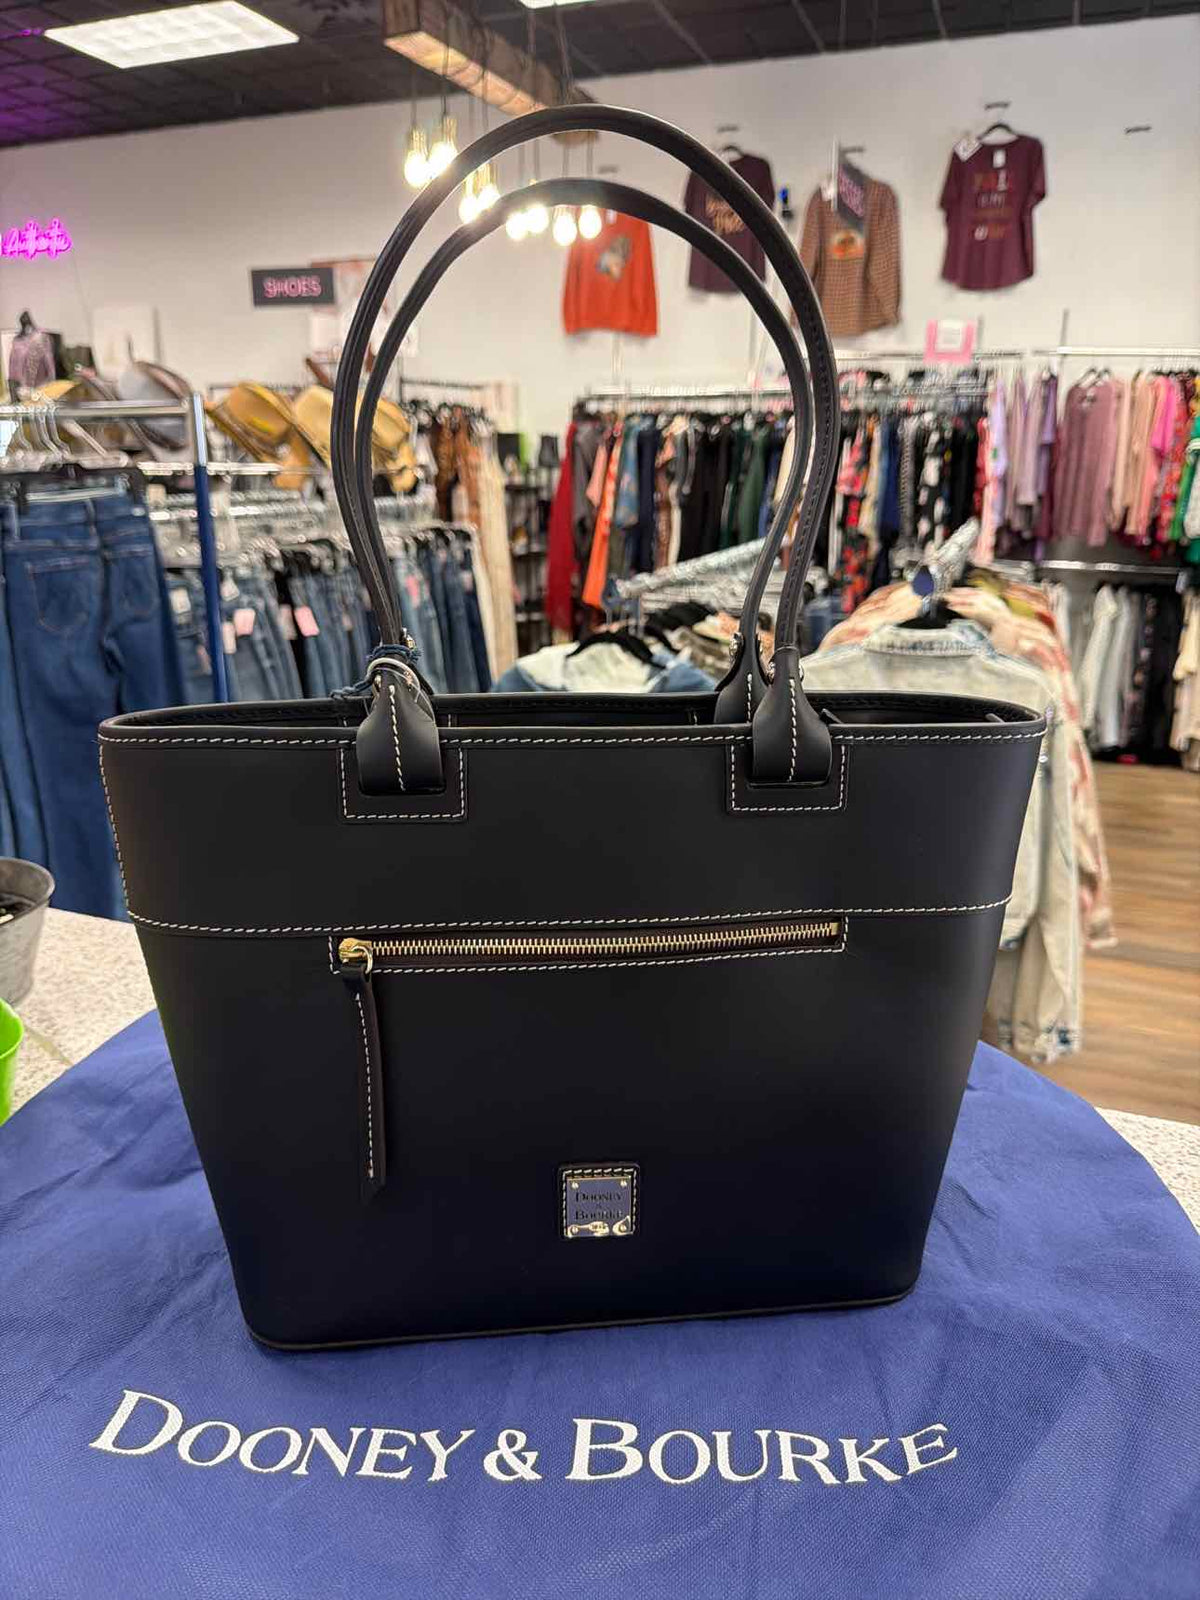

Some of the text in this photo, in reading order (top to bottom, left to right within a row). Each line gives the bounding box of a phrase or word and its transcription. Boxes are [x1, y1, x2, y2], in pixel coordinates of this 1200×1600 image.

[263, 277, 321, 298] SHOES
[89, 1389, 958, 1485] DOONEY & BOURKE
